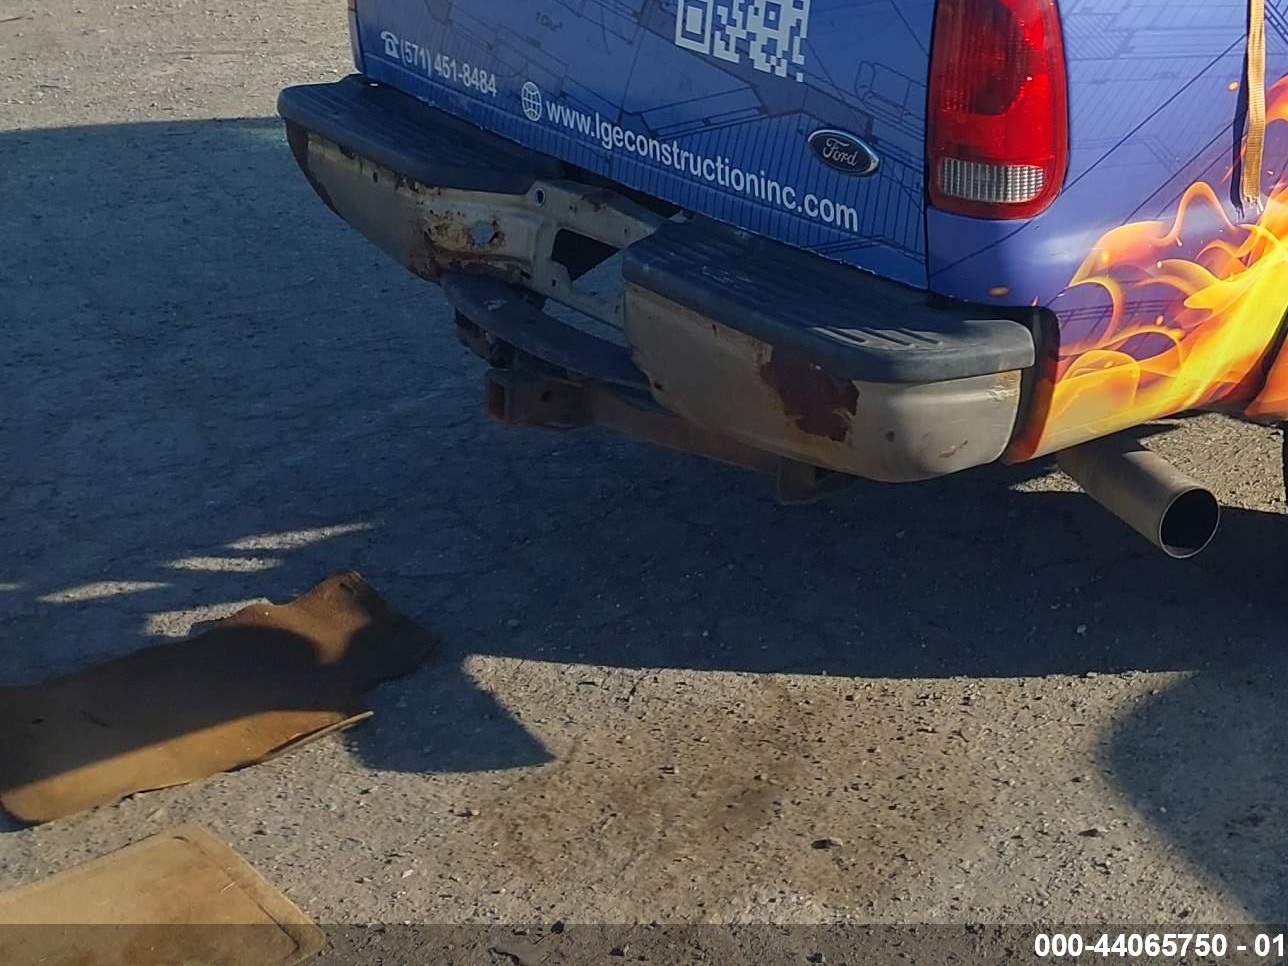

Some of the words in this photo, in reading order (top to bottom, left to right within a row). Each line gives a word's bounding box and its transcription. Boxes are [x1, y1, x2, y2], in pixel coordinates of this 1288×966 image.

[400, 39, 432, 77] (571)
[434, 53, 497, 98] 451-8484
[822, 137, 859, 166] Ford
